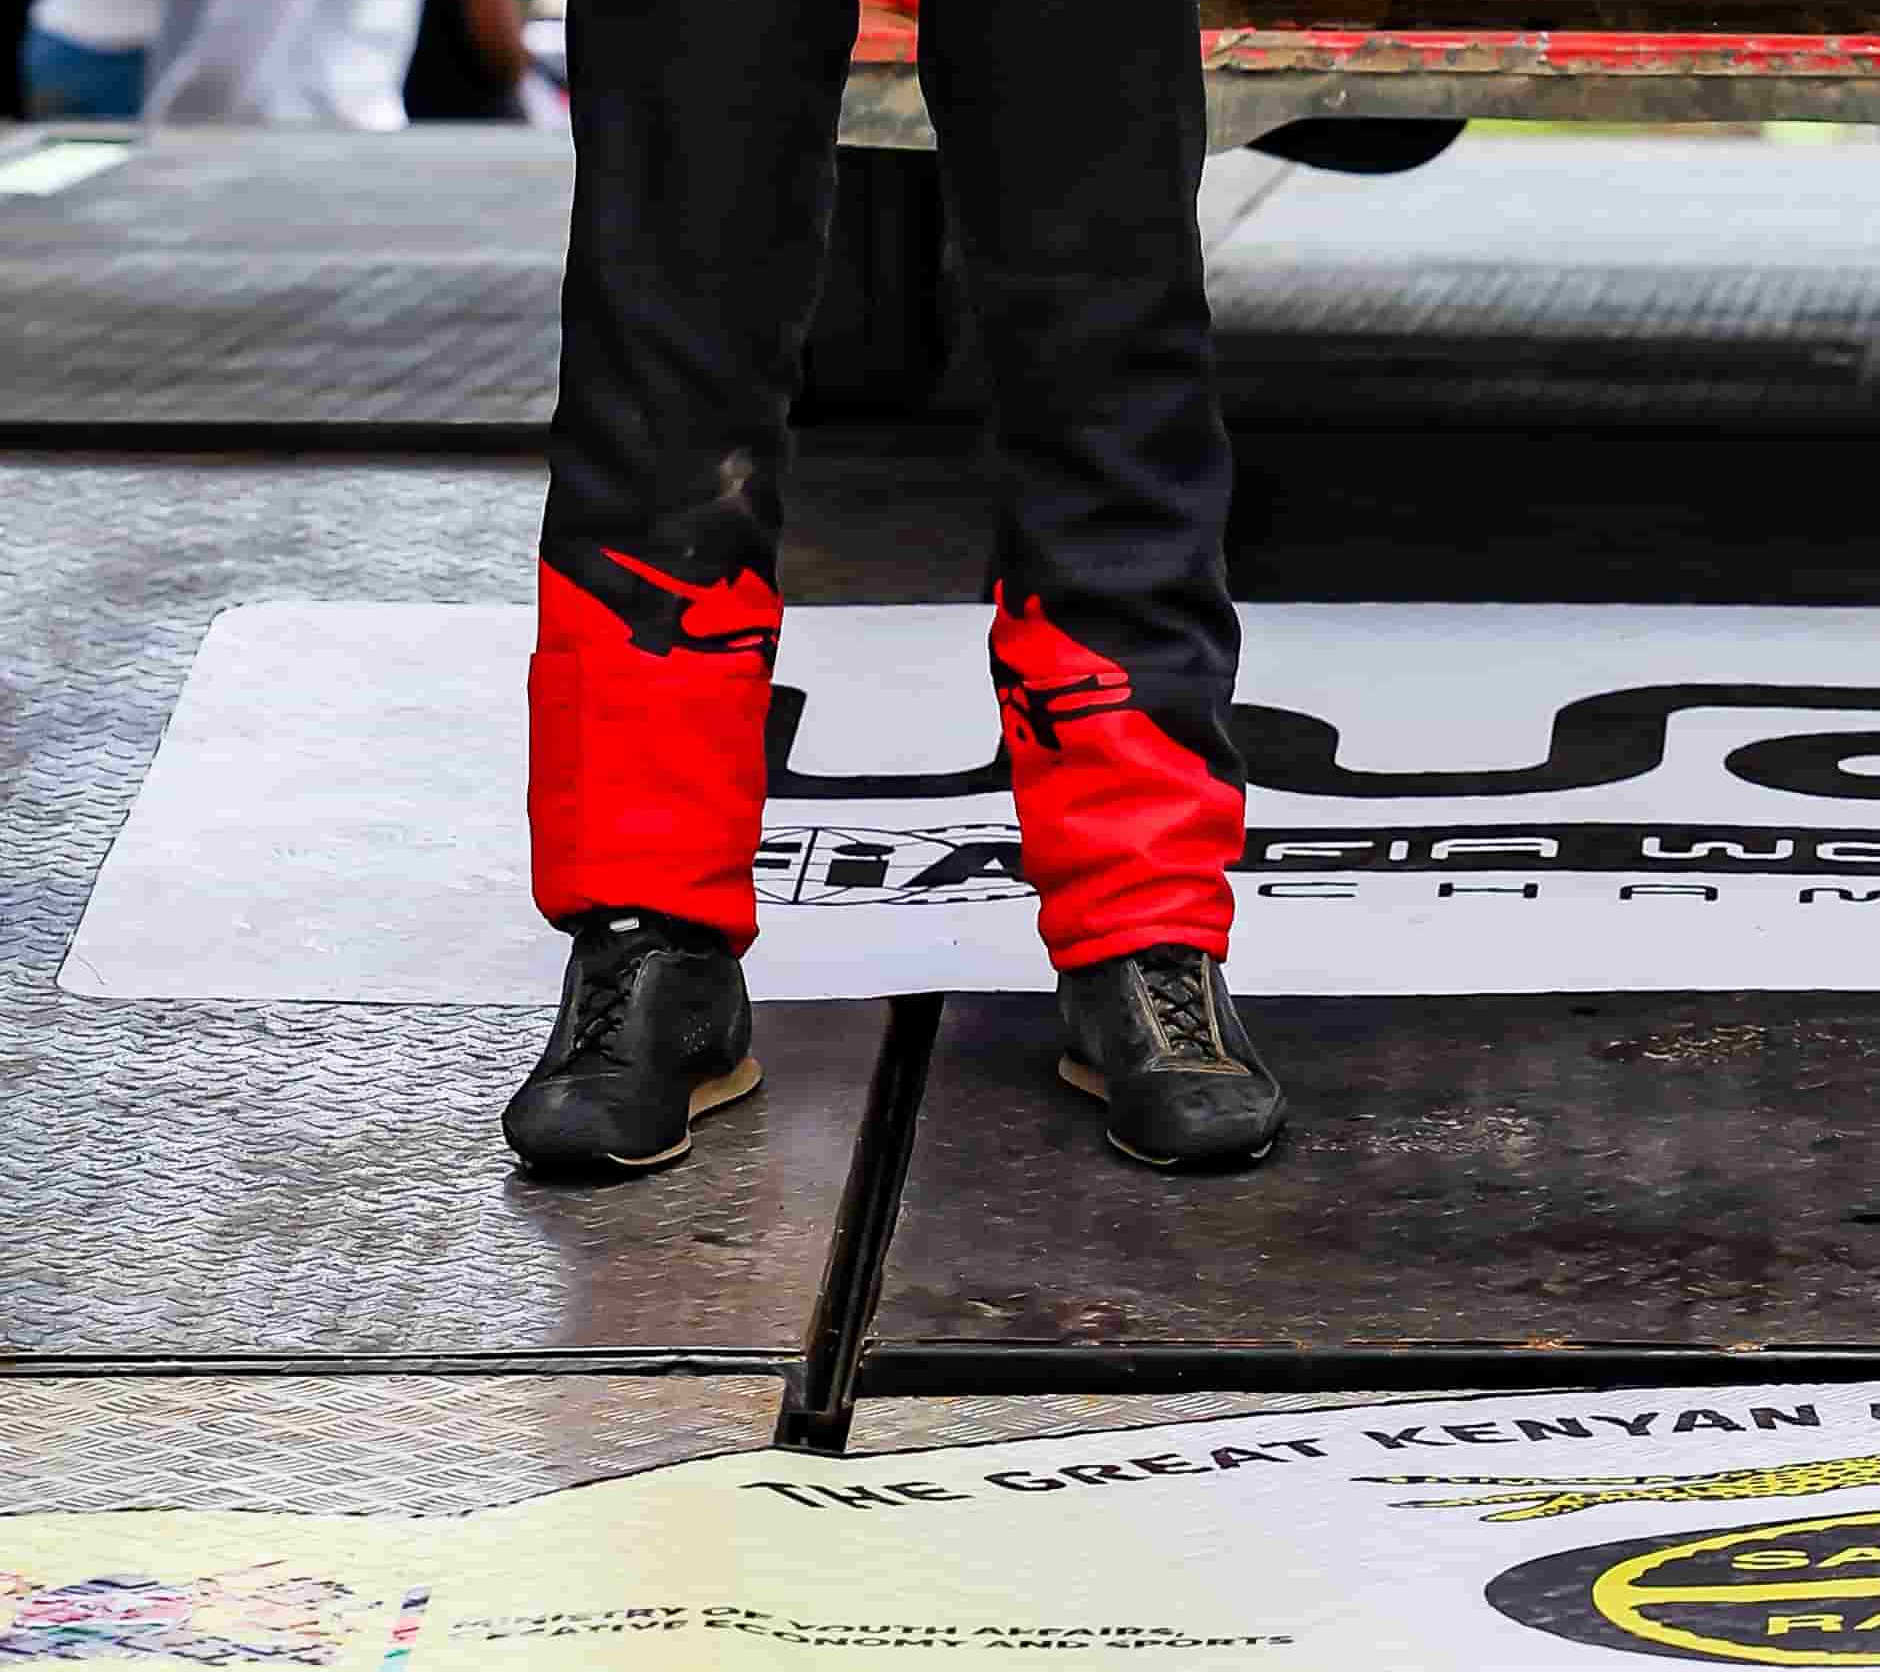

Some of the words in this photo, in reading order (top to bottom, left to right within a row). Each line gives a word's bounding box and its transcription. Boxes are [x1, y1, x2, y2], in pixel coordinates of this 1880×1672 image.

[1265, 837, 1559, 861] FIA
[738, 1479, 975, 1511] THE
[983, 1437, 1329, 1493] GREAT
[1362, 1403, 1822, 1450] KENYAN
[700, 1606, 773, 1621] OF
[789, 1620, 959, 1637] YOUTH
[702, 1618, 968, 1649] ECONOMY
[985, 1638, 1090, 1650] AND
[1104, 1634, 1296, 1650] SPORTS
